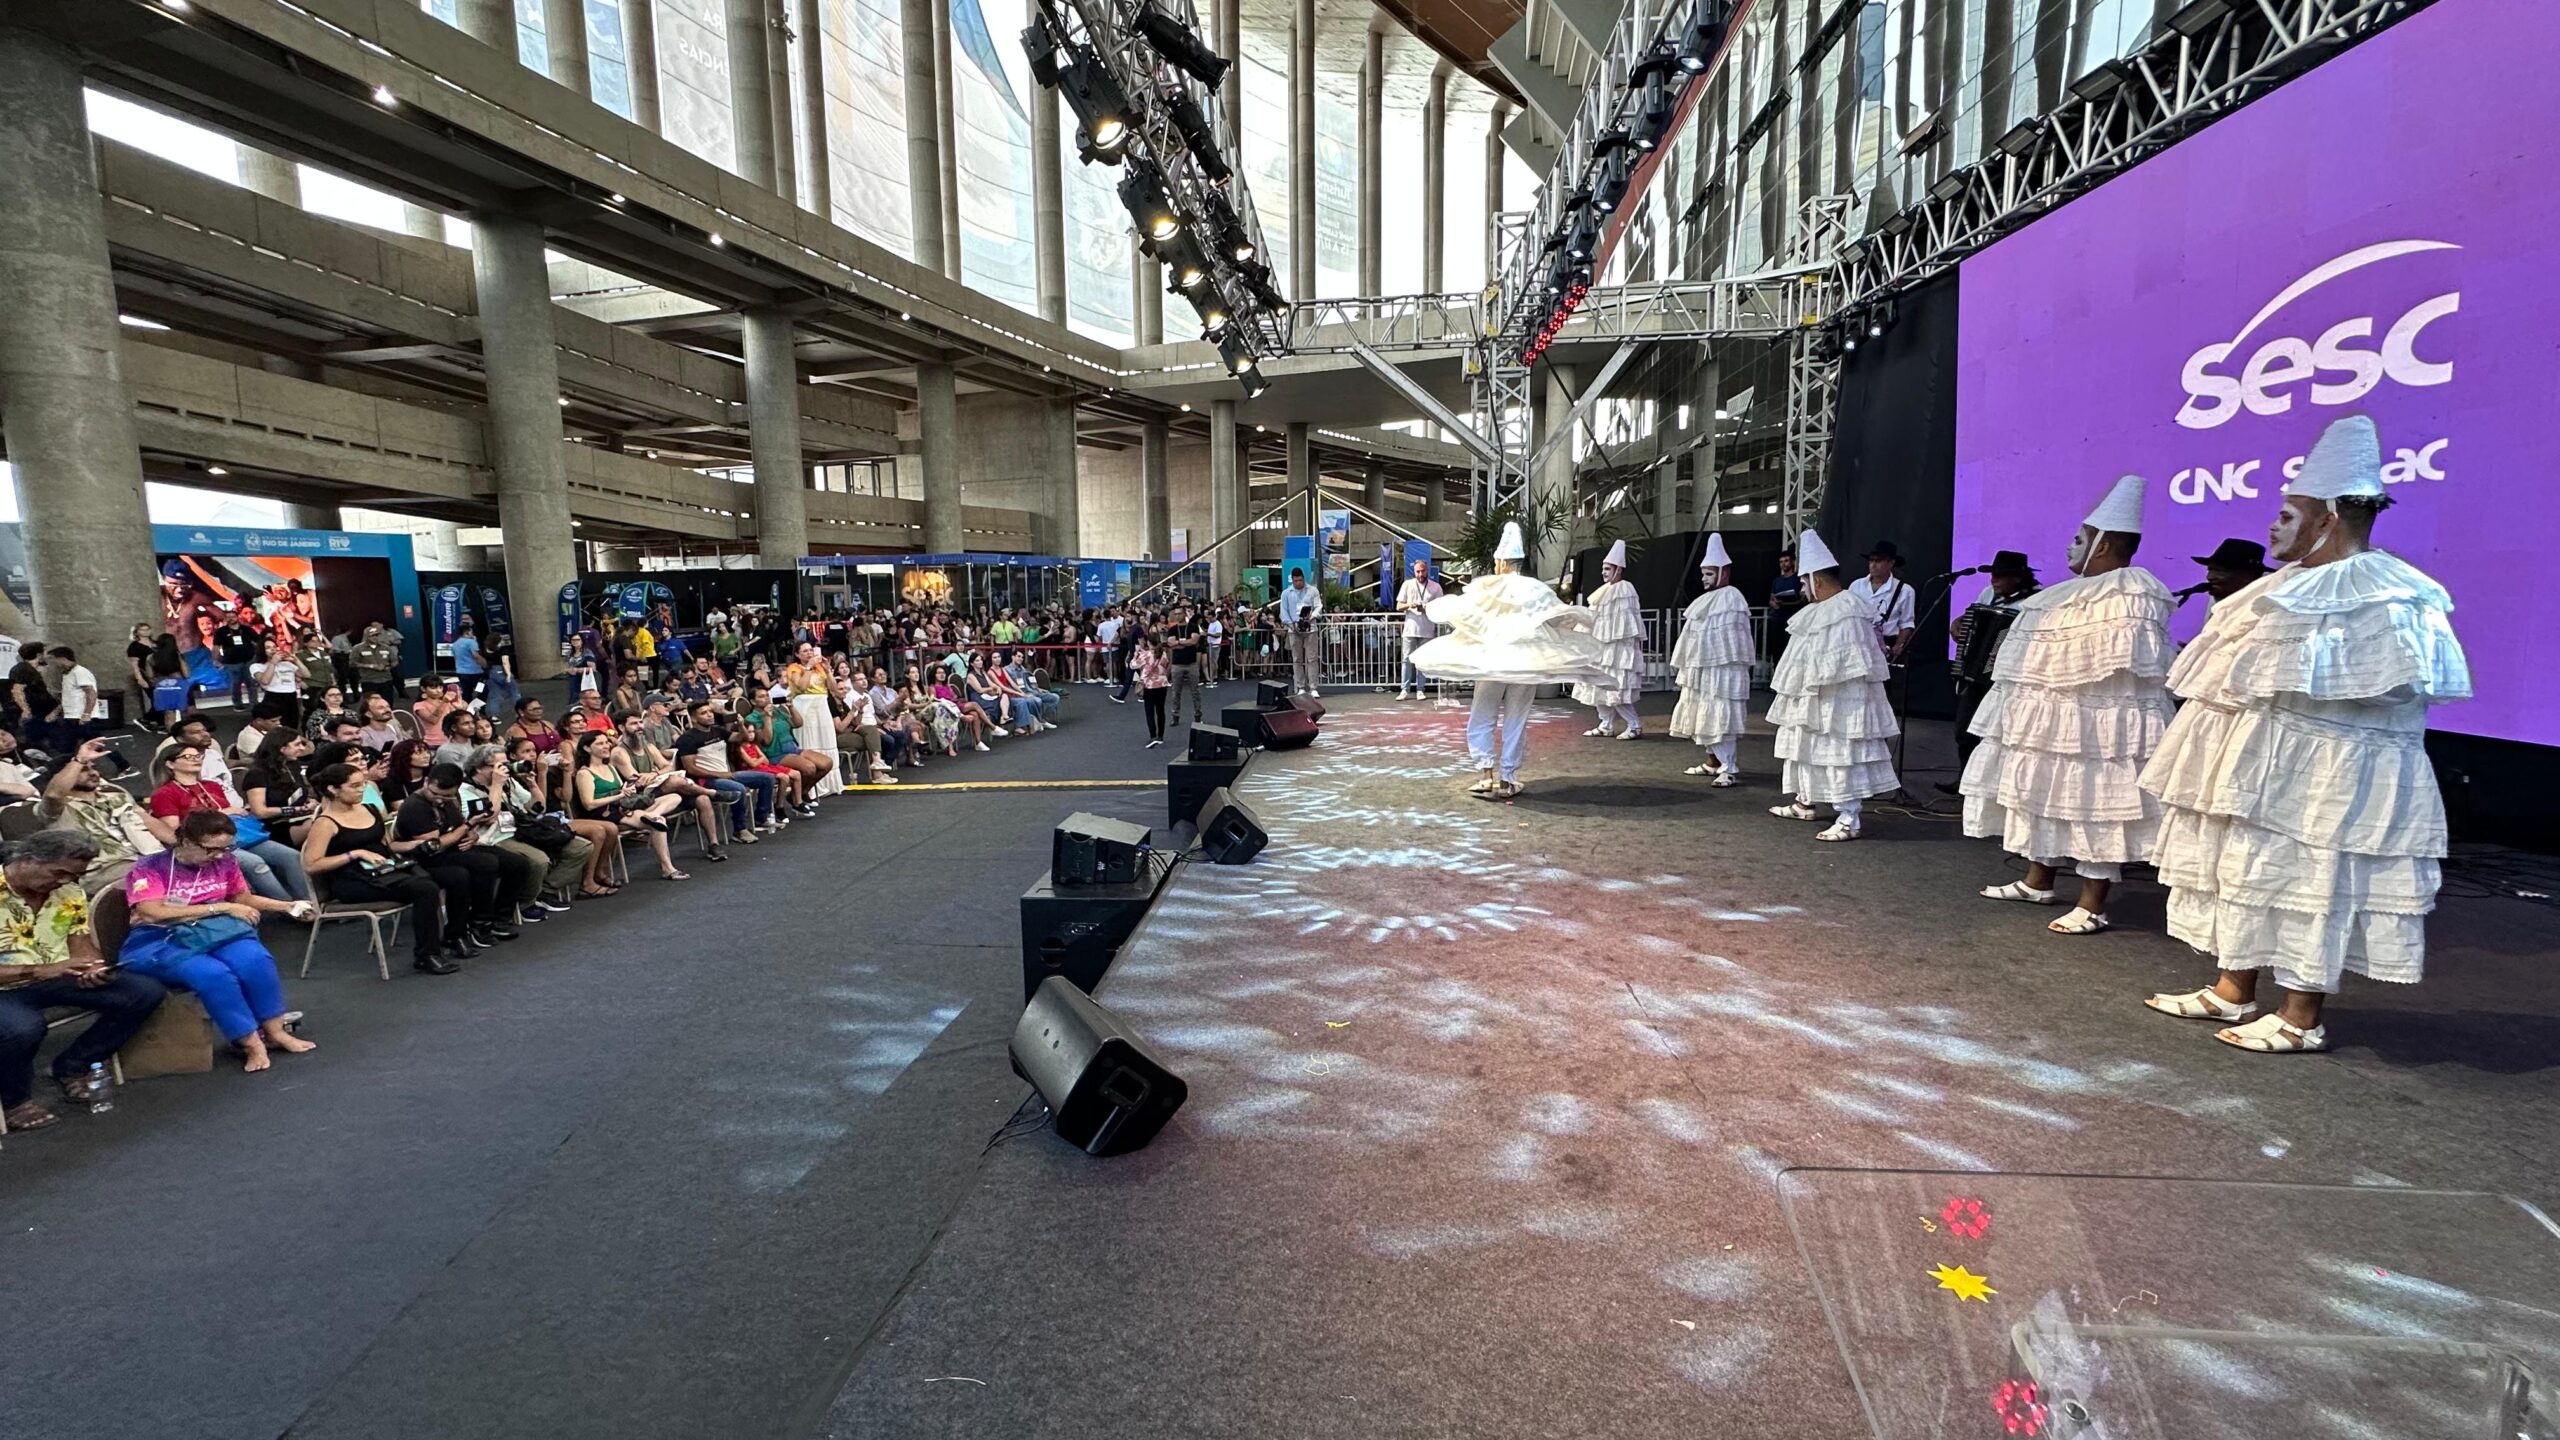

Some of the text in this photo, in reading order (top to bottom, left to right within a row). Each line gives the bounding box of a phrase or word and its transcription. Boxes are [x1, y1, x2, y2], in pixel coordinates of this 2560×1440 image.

[2175, 292, 2461, 429] sesc
[2169, 438, 2449, 504] CNC sac
